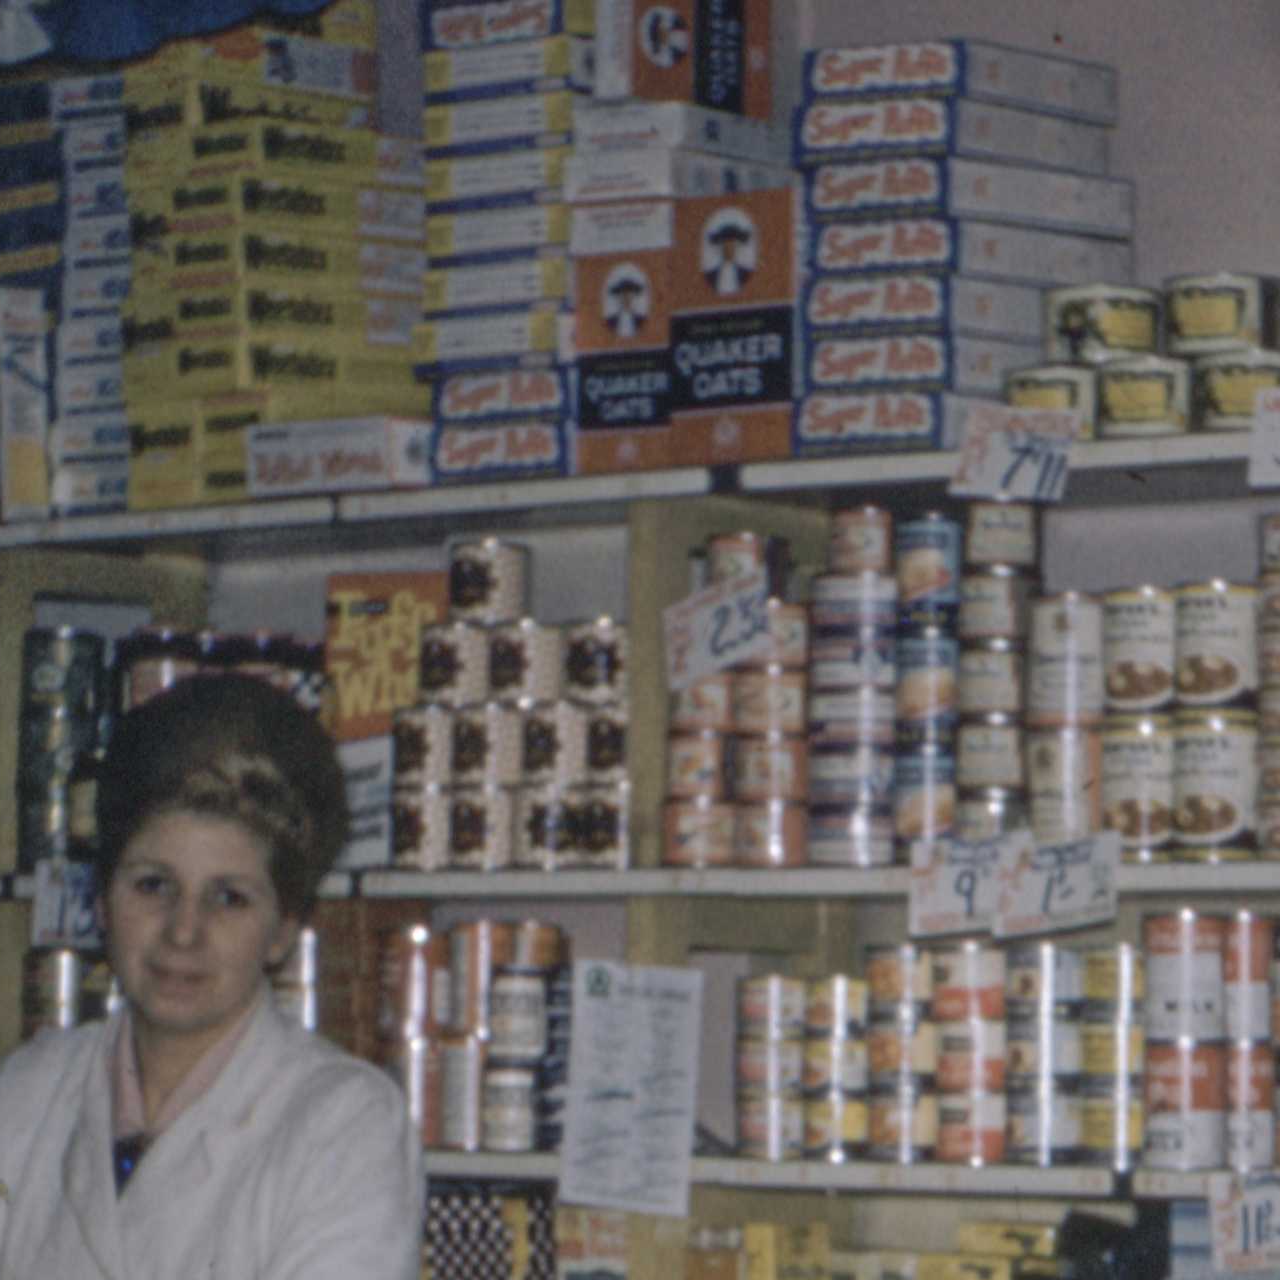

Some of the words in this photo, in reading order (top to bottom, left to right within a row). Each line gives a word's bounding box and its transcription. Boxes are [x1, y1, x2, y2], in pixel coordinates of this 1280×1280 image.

[675, 335, 782, 375] QUAKER
[585, 373, 670, 397] QUAKER
[694, 368, 762, 398] OATS
[603, 398, 653, 420] OATS
